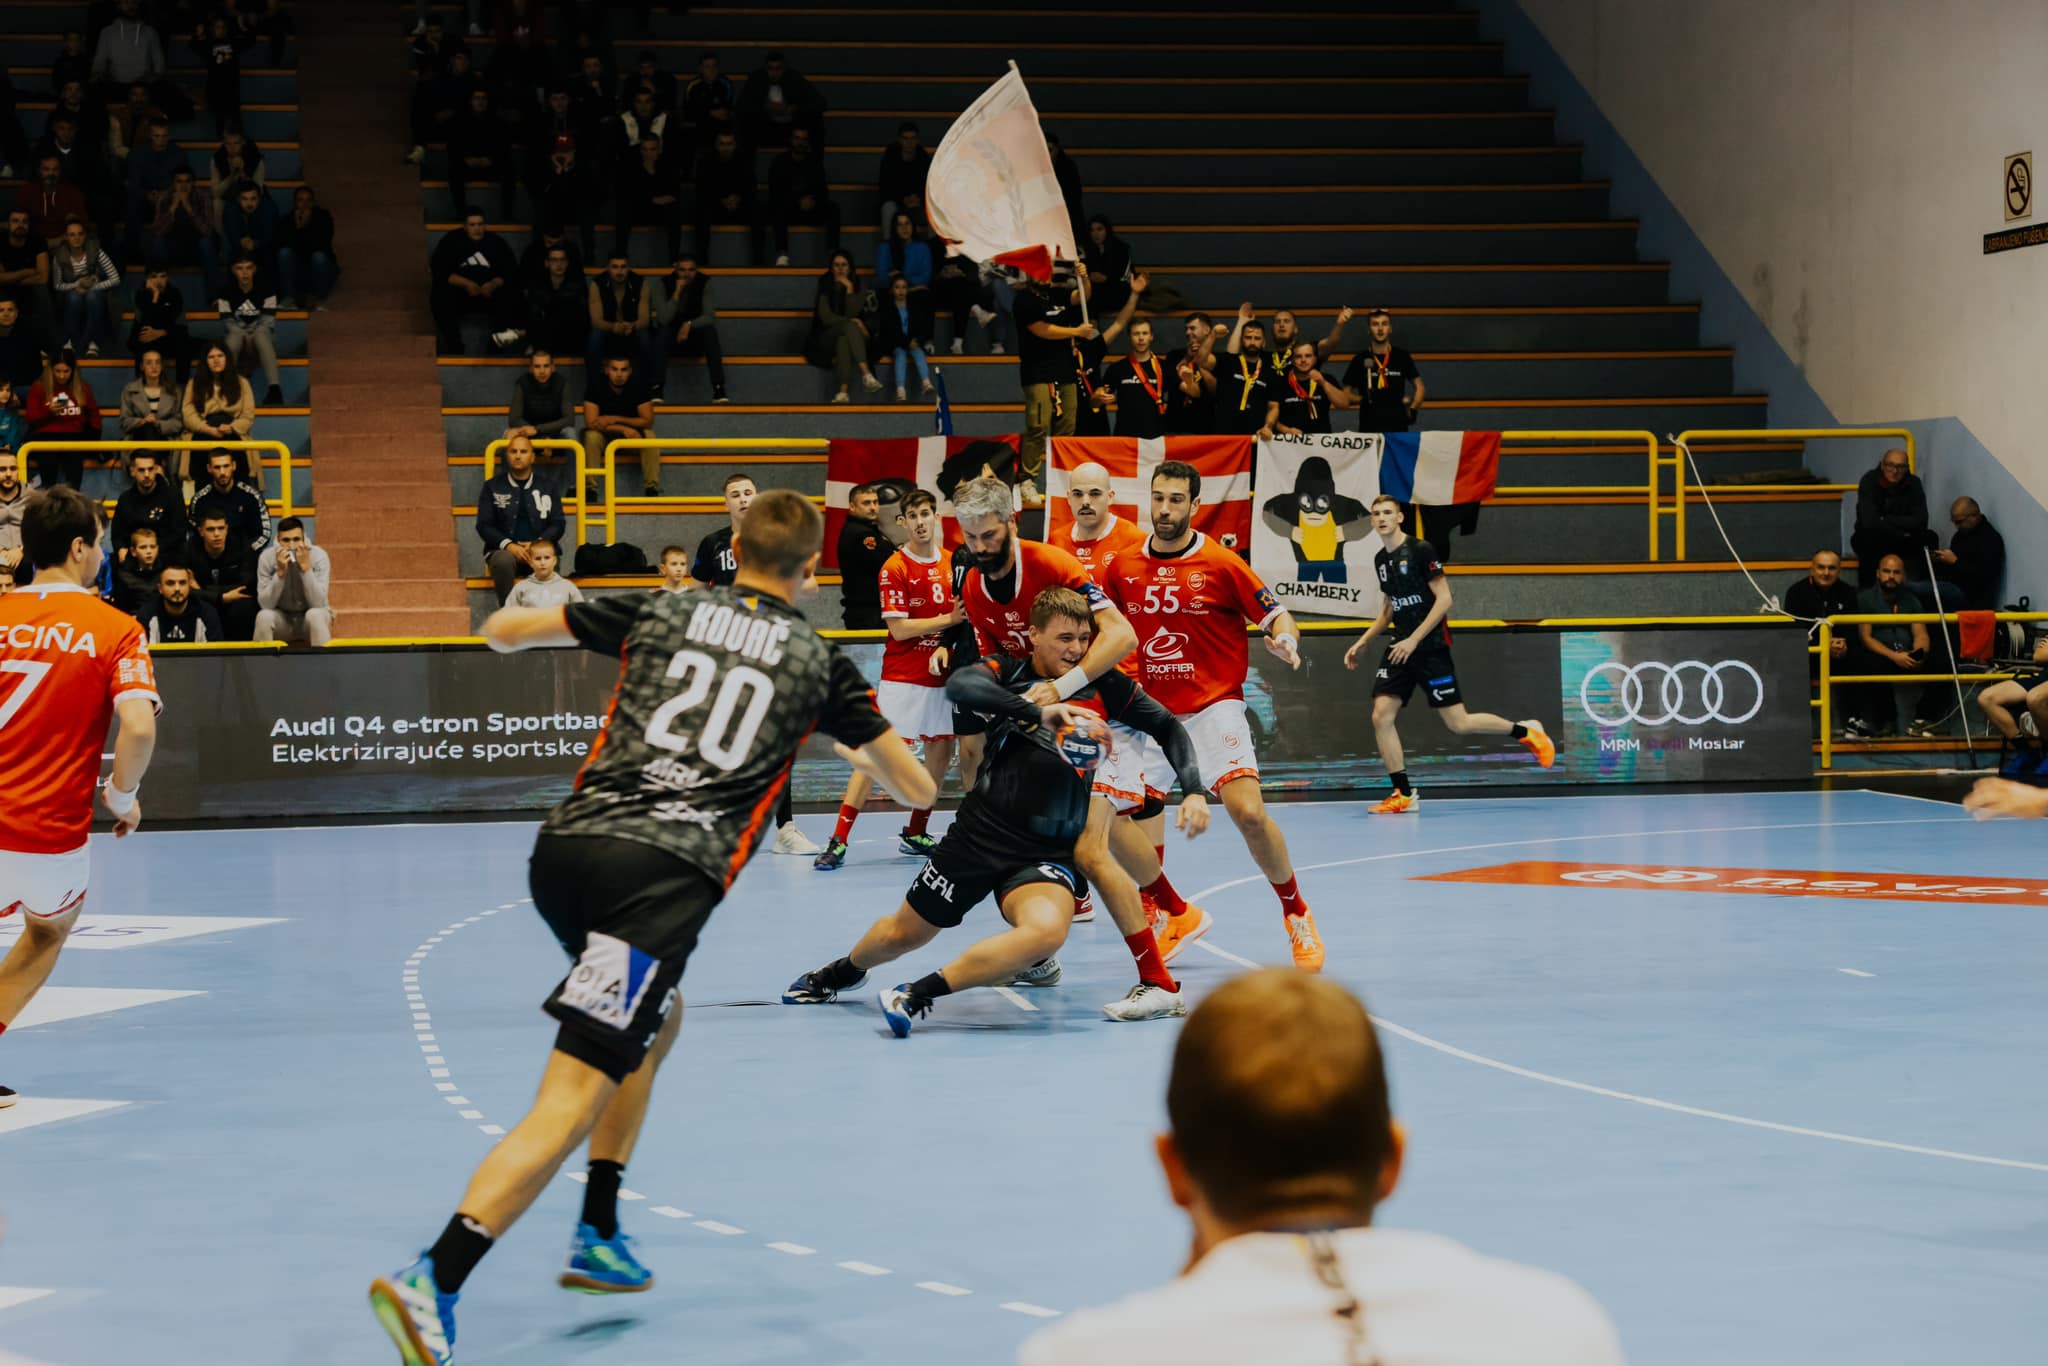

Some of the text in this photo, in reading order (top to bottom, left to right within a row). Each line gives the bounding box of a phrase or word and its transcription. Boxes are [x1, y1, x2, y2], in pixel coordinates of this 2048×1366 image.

[719, 548, 738, 572] 18
[932, 583, 945, 604] 8
[1143, 585, 1181, 614] 55
[1275, 582, 1361, 602] CHAMBERY
[644, 650, 775, 771] 20
[270, 717, 335, 737] Audi
[344, 715, 385, 737] Q4
[392, 715, 479, 734] e-tron
[272, 737, 589, 764] Elektrizirajuće sportske
[1601, 738, 1640, 752] MRM
